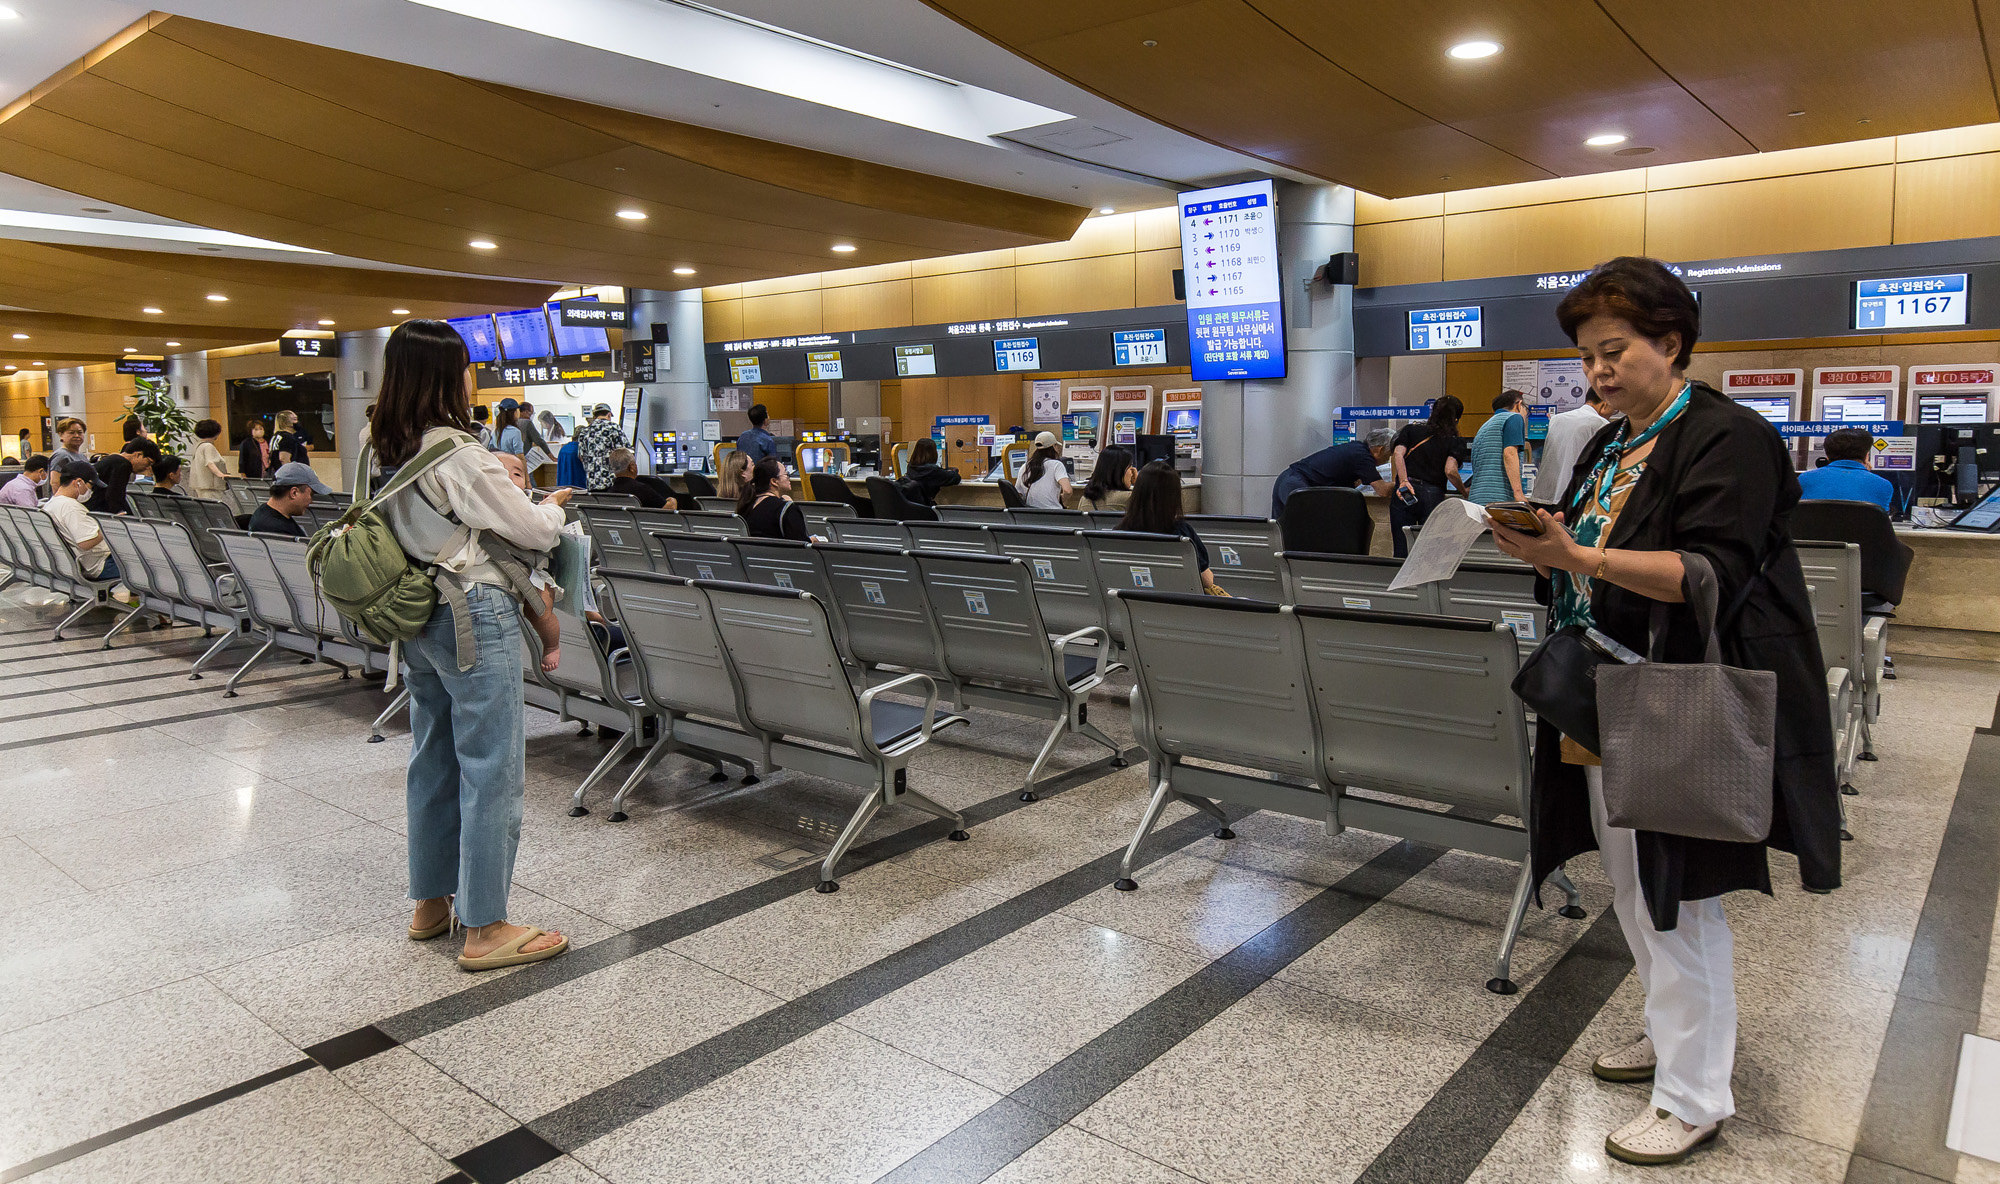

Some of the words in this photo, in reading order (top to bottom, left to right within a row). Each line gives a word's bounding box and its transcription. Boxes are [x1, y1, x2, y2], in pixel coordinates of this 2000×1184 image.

[1191, 219, 1196, 227] 4
[1219, 214, 1238, 224] 1171
[1192, 234, 1197, 242] 3
[1220, 229, 1240, 238] 1170
[1194, 248, 1198, 256] 5
[1220, 243, 1240, 253] 1169
[1222, 257, 1242, 267] 1168
[1223, 272, 1242, 281] 1167
[1224, 286, 1244, 295] 1165
[1898, 297, 1952, 314] 1167
[1198, 314, 1212, 325] 입원
[1214, 312, 1229, 324] 관련
[1231, 310, 1270, 322] 원무서류는
[1869, 310, 1875, 321] 1
[1196, 327, 1210, 338] 뒷편
[1212, 325, 1234, 337] 원무팀
[1236, 322, 1274, 335] 사무실에서
[1436, 325, 1472, 339] 1170
[1207, 339, 1221, 350] 발급
[1224, 337, 1264, 350] 가능합니다.
[1417, 335, 1423, 344] 3
[1134, 344, 1158, 356] 1171
[1012, 352, 1034, 362] 1169
[1120, 352, 1125, 360] 4
[1240, 351, 1252, 360] 서류
[820, 363, 838, 373] 7023
[505, 368, 520, 383] 약국
[1736, 376, 1750, 385] 영상
[1753, 376, 1764, 384] CD
[1827, 373, 1843, 383] 영상
[1846, 373, 1857, 381] CD
[1942, 373, 1957, 382] CD
[1872, 424, 1889, 433] 창구
